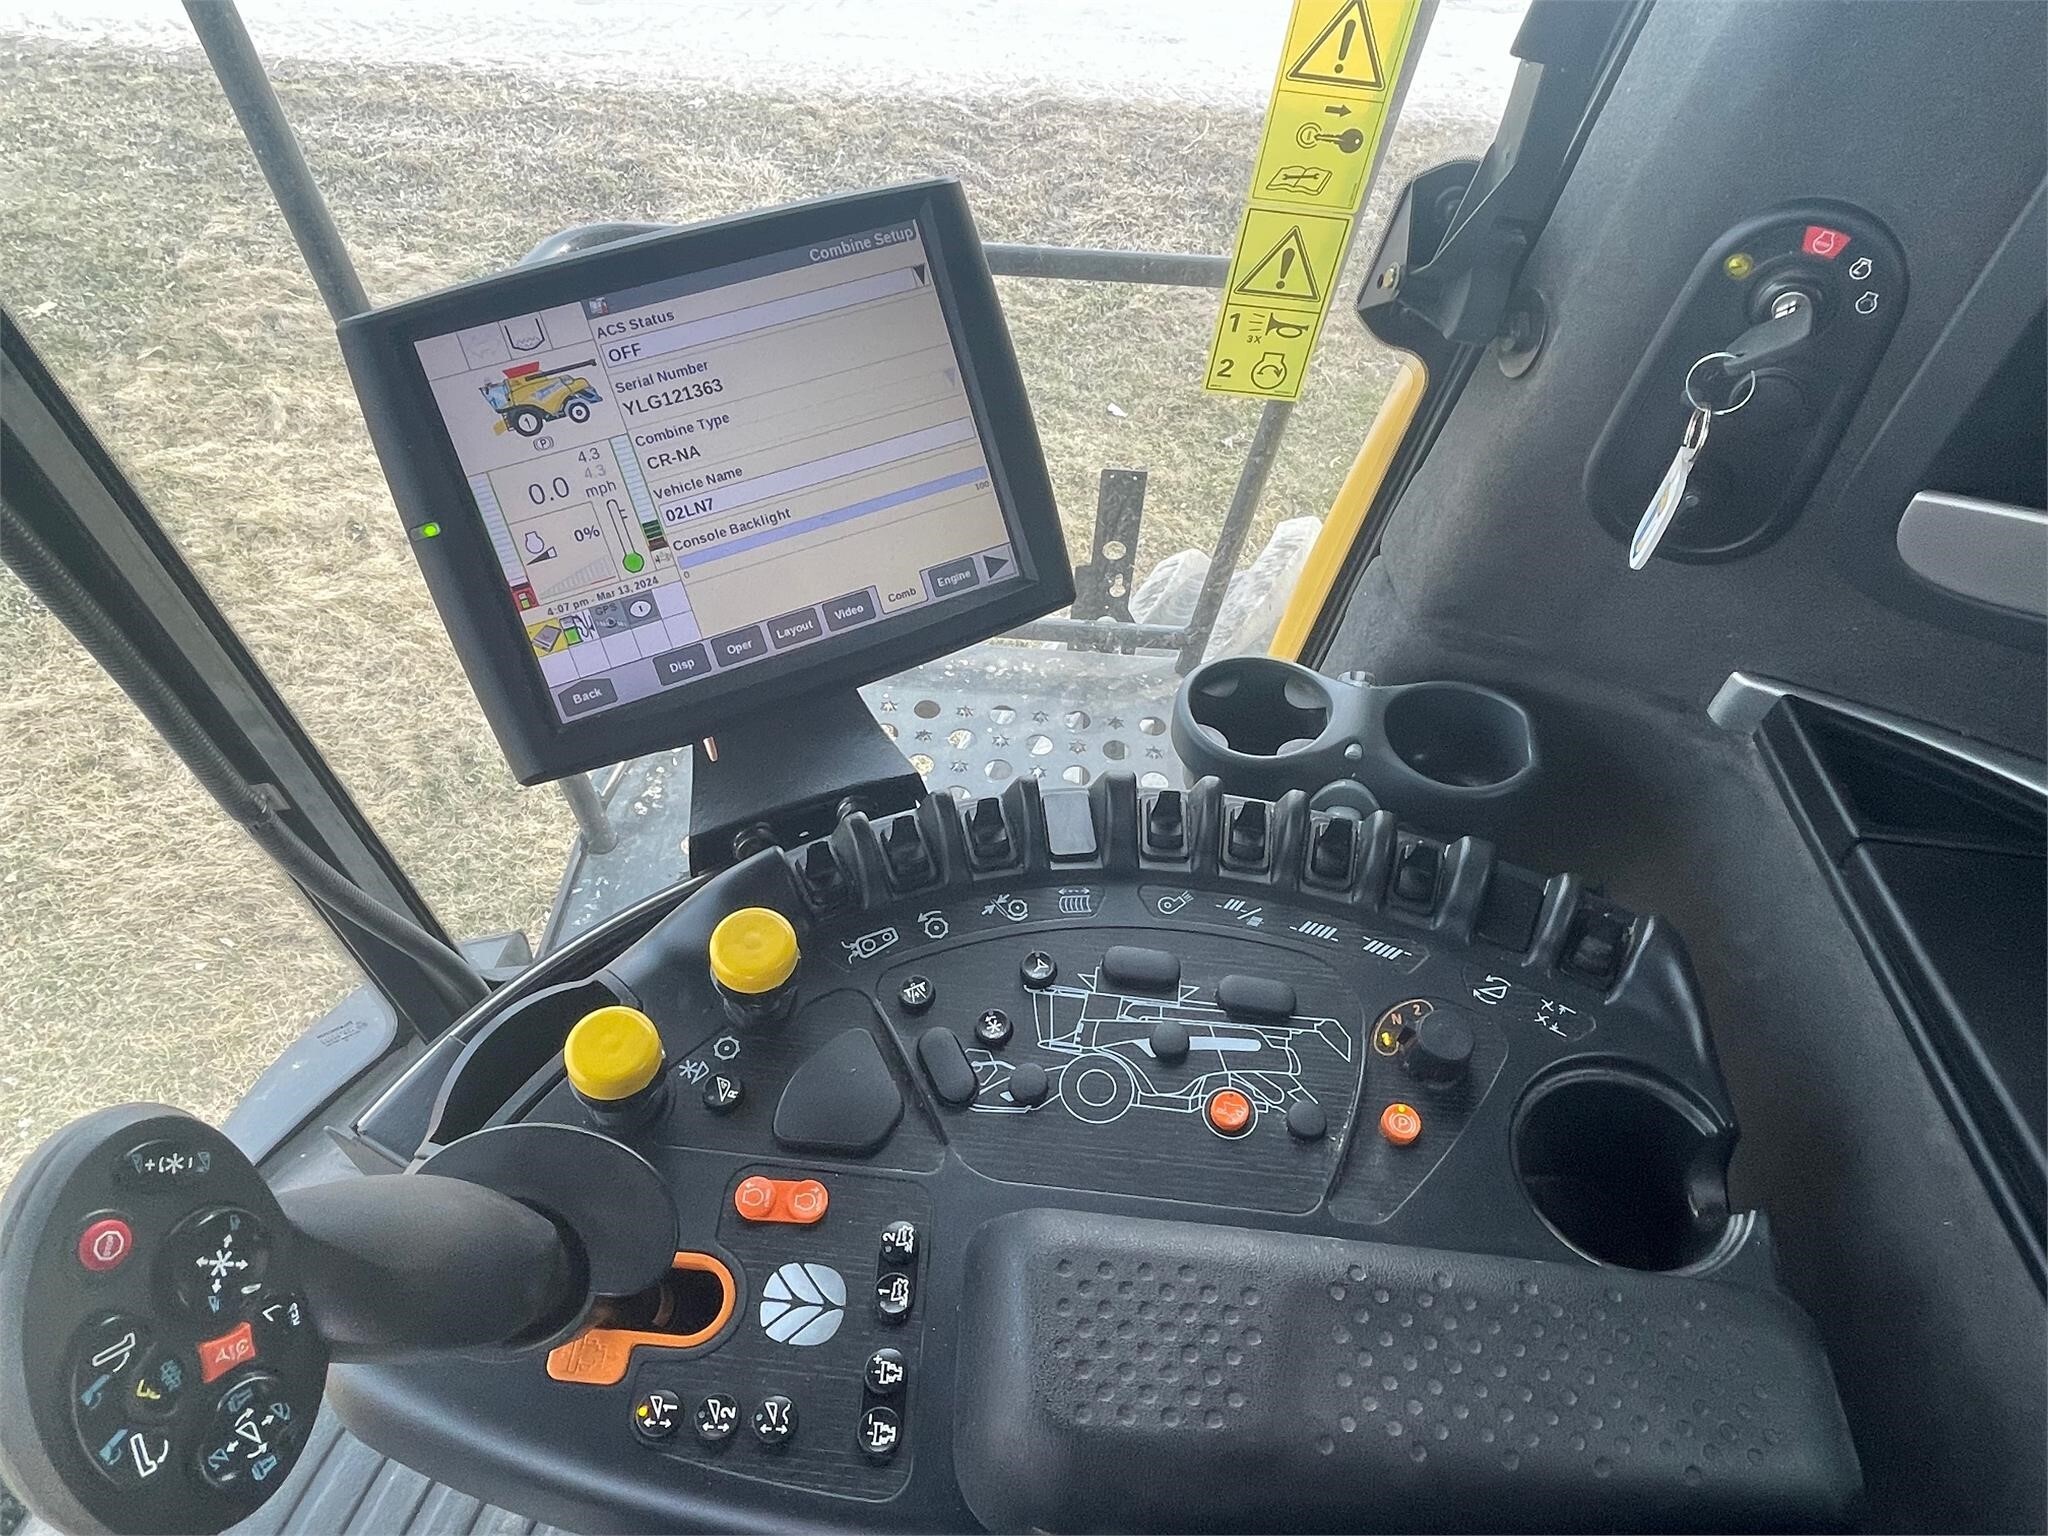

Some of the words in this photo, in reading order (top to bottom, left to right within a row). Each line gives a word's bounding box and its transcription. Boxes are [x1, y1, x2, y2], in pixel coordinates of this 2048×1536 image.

[809, 238, 872, 262] Combine
[873, 228, 914, 246] Setup
[597, 321, 627, 339] ACS
[629, 311, 675, 330] Status
[1229, 312, 1241, 333] 1
[1246, 335, 1262, 345] 3X
[608, 343, 642, 362] OFF
[615, 373, 655, 394] Serial
[656, 360, 709, 383] Number
[1216, 358, 1235, 378] 2
[622, 378, 724, 416] YLG121363
[635, 423, 694, 447] Combine
[696, 413, 730, 431] Type
[578, 447, 600, 462] 4.3
[647, 445, 701, 470] CR-NA
[528, 477, 570, 505] 0.0
[585, 480, 617, 498] mph
[653, 477, 704, 500] Vehicle
[705, 467, 743, 485] Name
[975, 480, 990, 491] 100
[665, 497, 714, 522] 02LN7
[573, 525, 600, 542] 0%
[673, 528, 727, 551] Console
[729, 508, 792, 535] Backlight
[683, 571, 690, 579] 0
[936, 569, 972, 588] Engine
[547, 603, 569, 616] 4:07
[573, 599, 590, 610] pm
[596, 591, 616, 602] Mar
[634, 576, 659, 589] 2024
[888, 588, 917, 603] Comb
[595, 603, 617, 616] GPS
[834, 603, 864, 621] Video
[776, 620, 814, 640] Layout
[727, 641, 753, 656] Oper
[669, 659, 695, 674] Disp
[572, 688, 603, 705] Back
[1391, 1013, 1402, 1025] N
[1412, 1004, 1422, 1016] 2
[720, 1406, 736, 1419] 2
